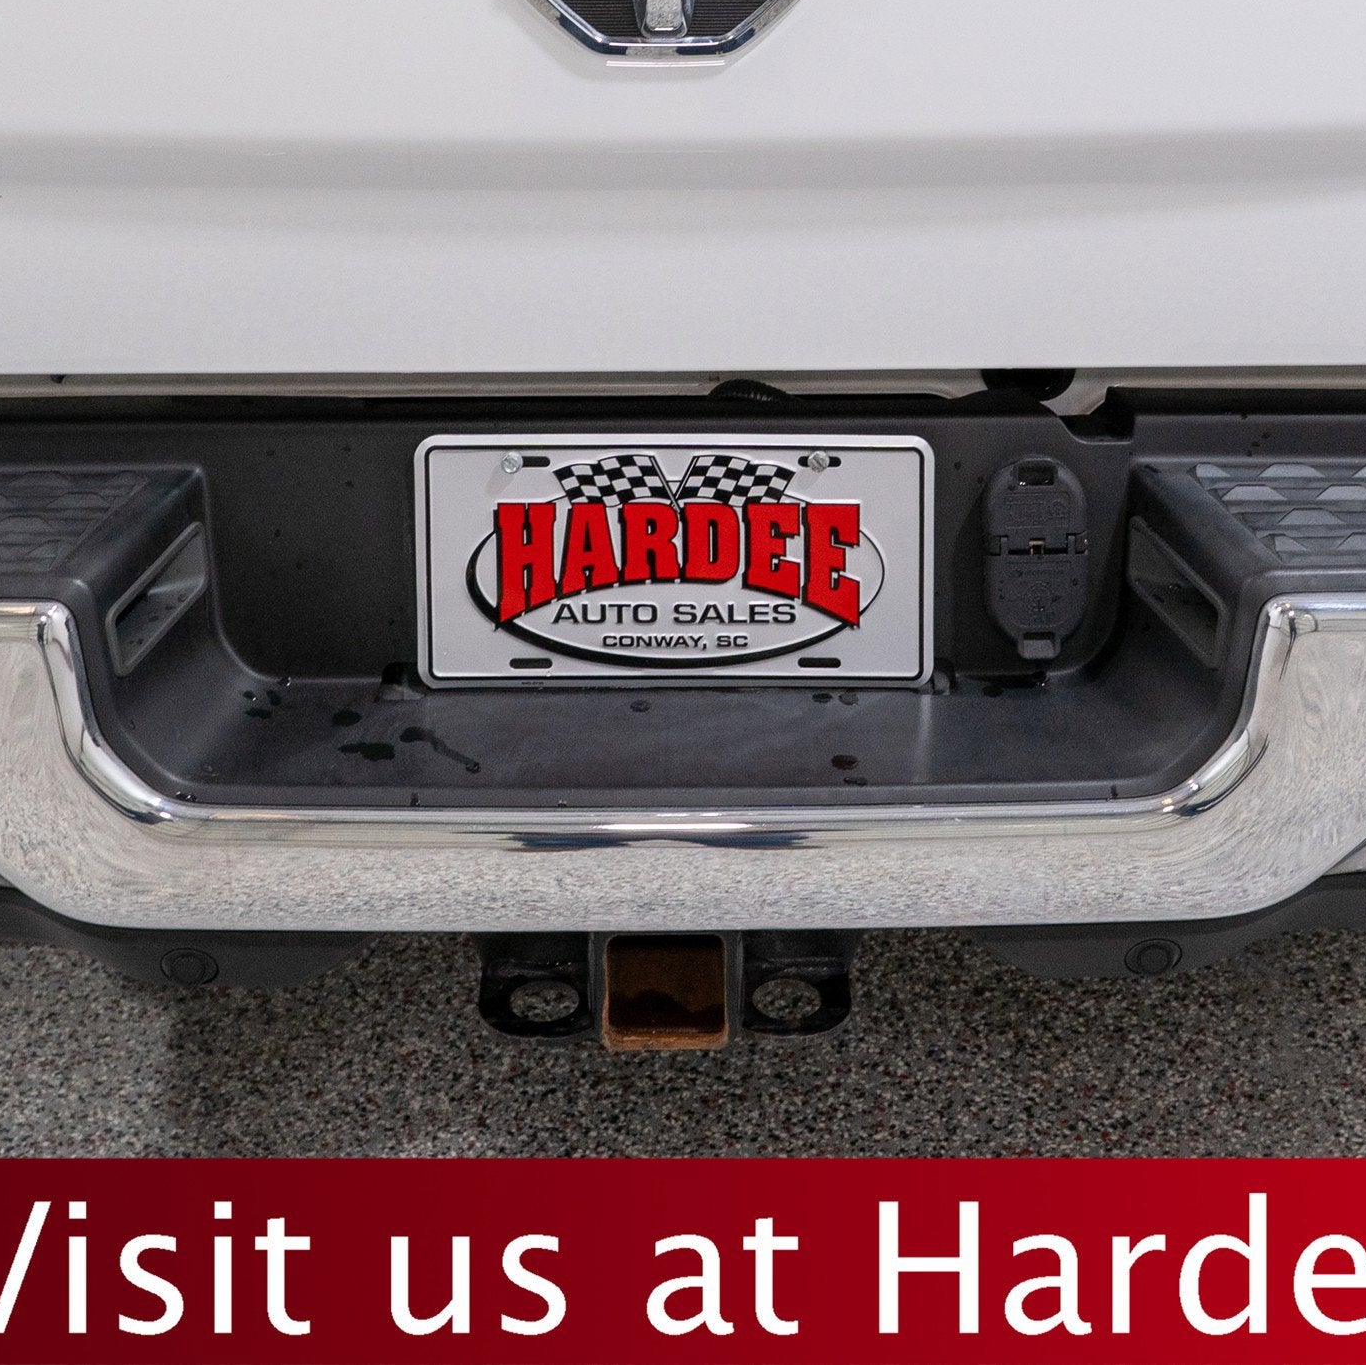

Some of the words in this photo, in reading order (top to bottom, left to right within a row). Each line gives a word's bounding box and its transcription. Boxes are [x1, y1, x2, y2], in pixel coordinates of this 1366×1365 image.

[492, 502, 861, 631] HARDEE
[552, 603, 658, 624] AUTO
[673, 603, 797, 624] SALES
[602, 635, 708, 651] CONWAY,
[716, 635, 749, 648] SC
